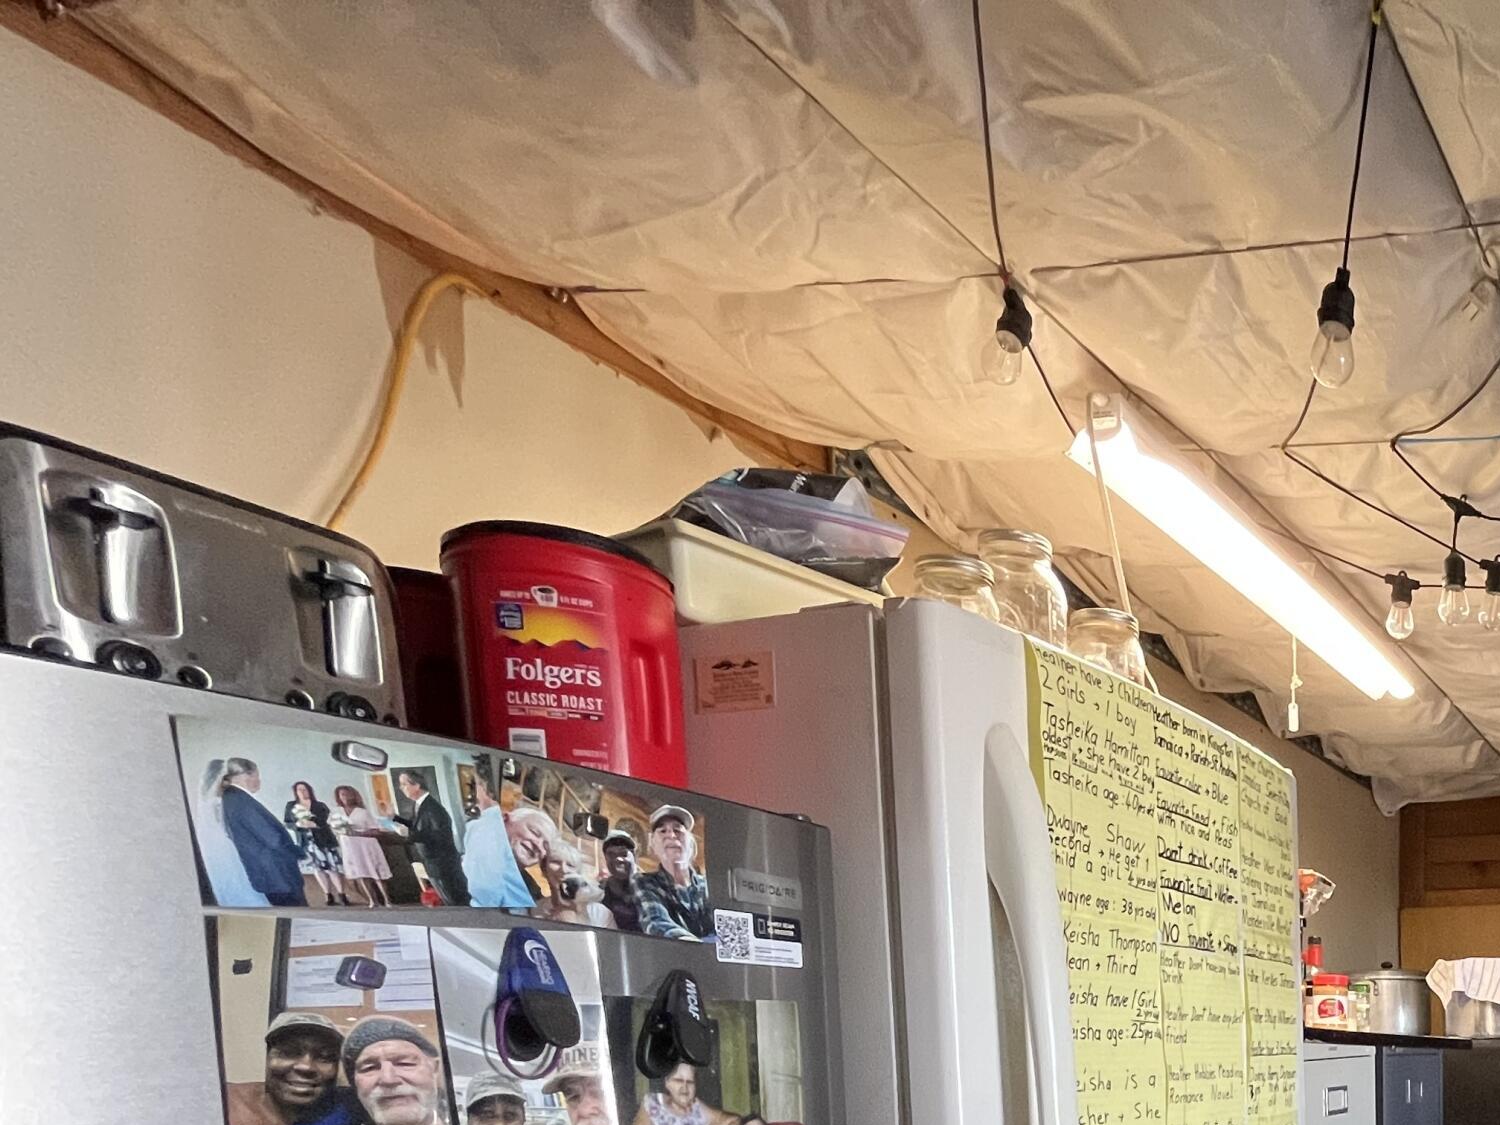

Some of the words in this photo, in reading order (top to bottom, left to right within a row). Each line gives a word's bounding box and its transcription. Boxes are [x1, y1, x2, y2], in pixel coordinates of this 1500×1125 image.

[505, 656, 602, 689] Folgers
[1079, 663, 1102, 689] have
[1107, 677, 1114, 694] 3
[507, 690, 558, 708] CLASSIC
[560, 694, 604, 711] ROAST
[1040, 664, 1053, 690] 2
[1116, 703, 1137, 736] boy
[1132, 764, 1139, 780] 2
[1211, 781, 1229, 806] Blue
[1046, 803, 1090, 839] Dwayne
[1105, 822, 1147, 855] Shaw
[1053, 848, 1077, 869] hild
[1085, 860, 1093, 874] a
[1108, 847, 1121, 864] He
[1056, 887, 1092, 911] wayne
[1161, 890, 1197, 918] Melon
[1063, 919, 1101, 947] Keisha
[1108, 928, 1158, 958] Thompson
[1106, 954, 1139, 976] Third
[1068, 982, 1099, 1008] eisha
[1105, 985, 1129, 1008] have
[1071, 1017, 1102, 1041] isha
[1075, 1066, 1112, 1093] eisha
[1148, 1074, 1157, 1089] a
[1134, 1101, 1162, 1120] She
